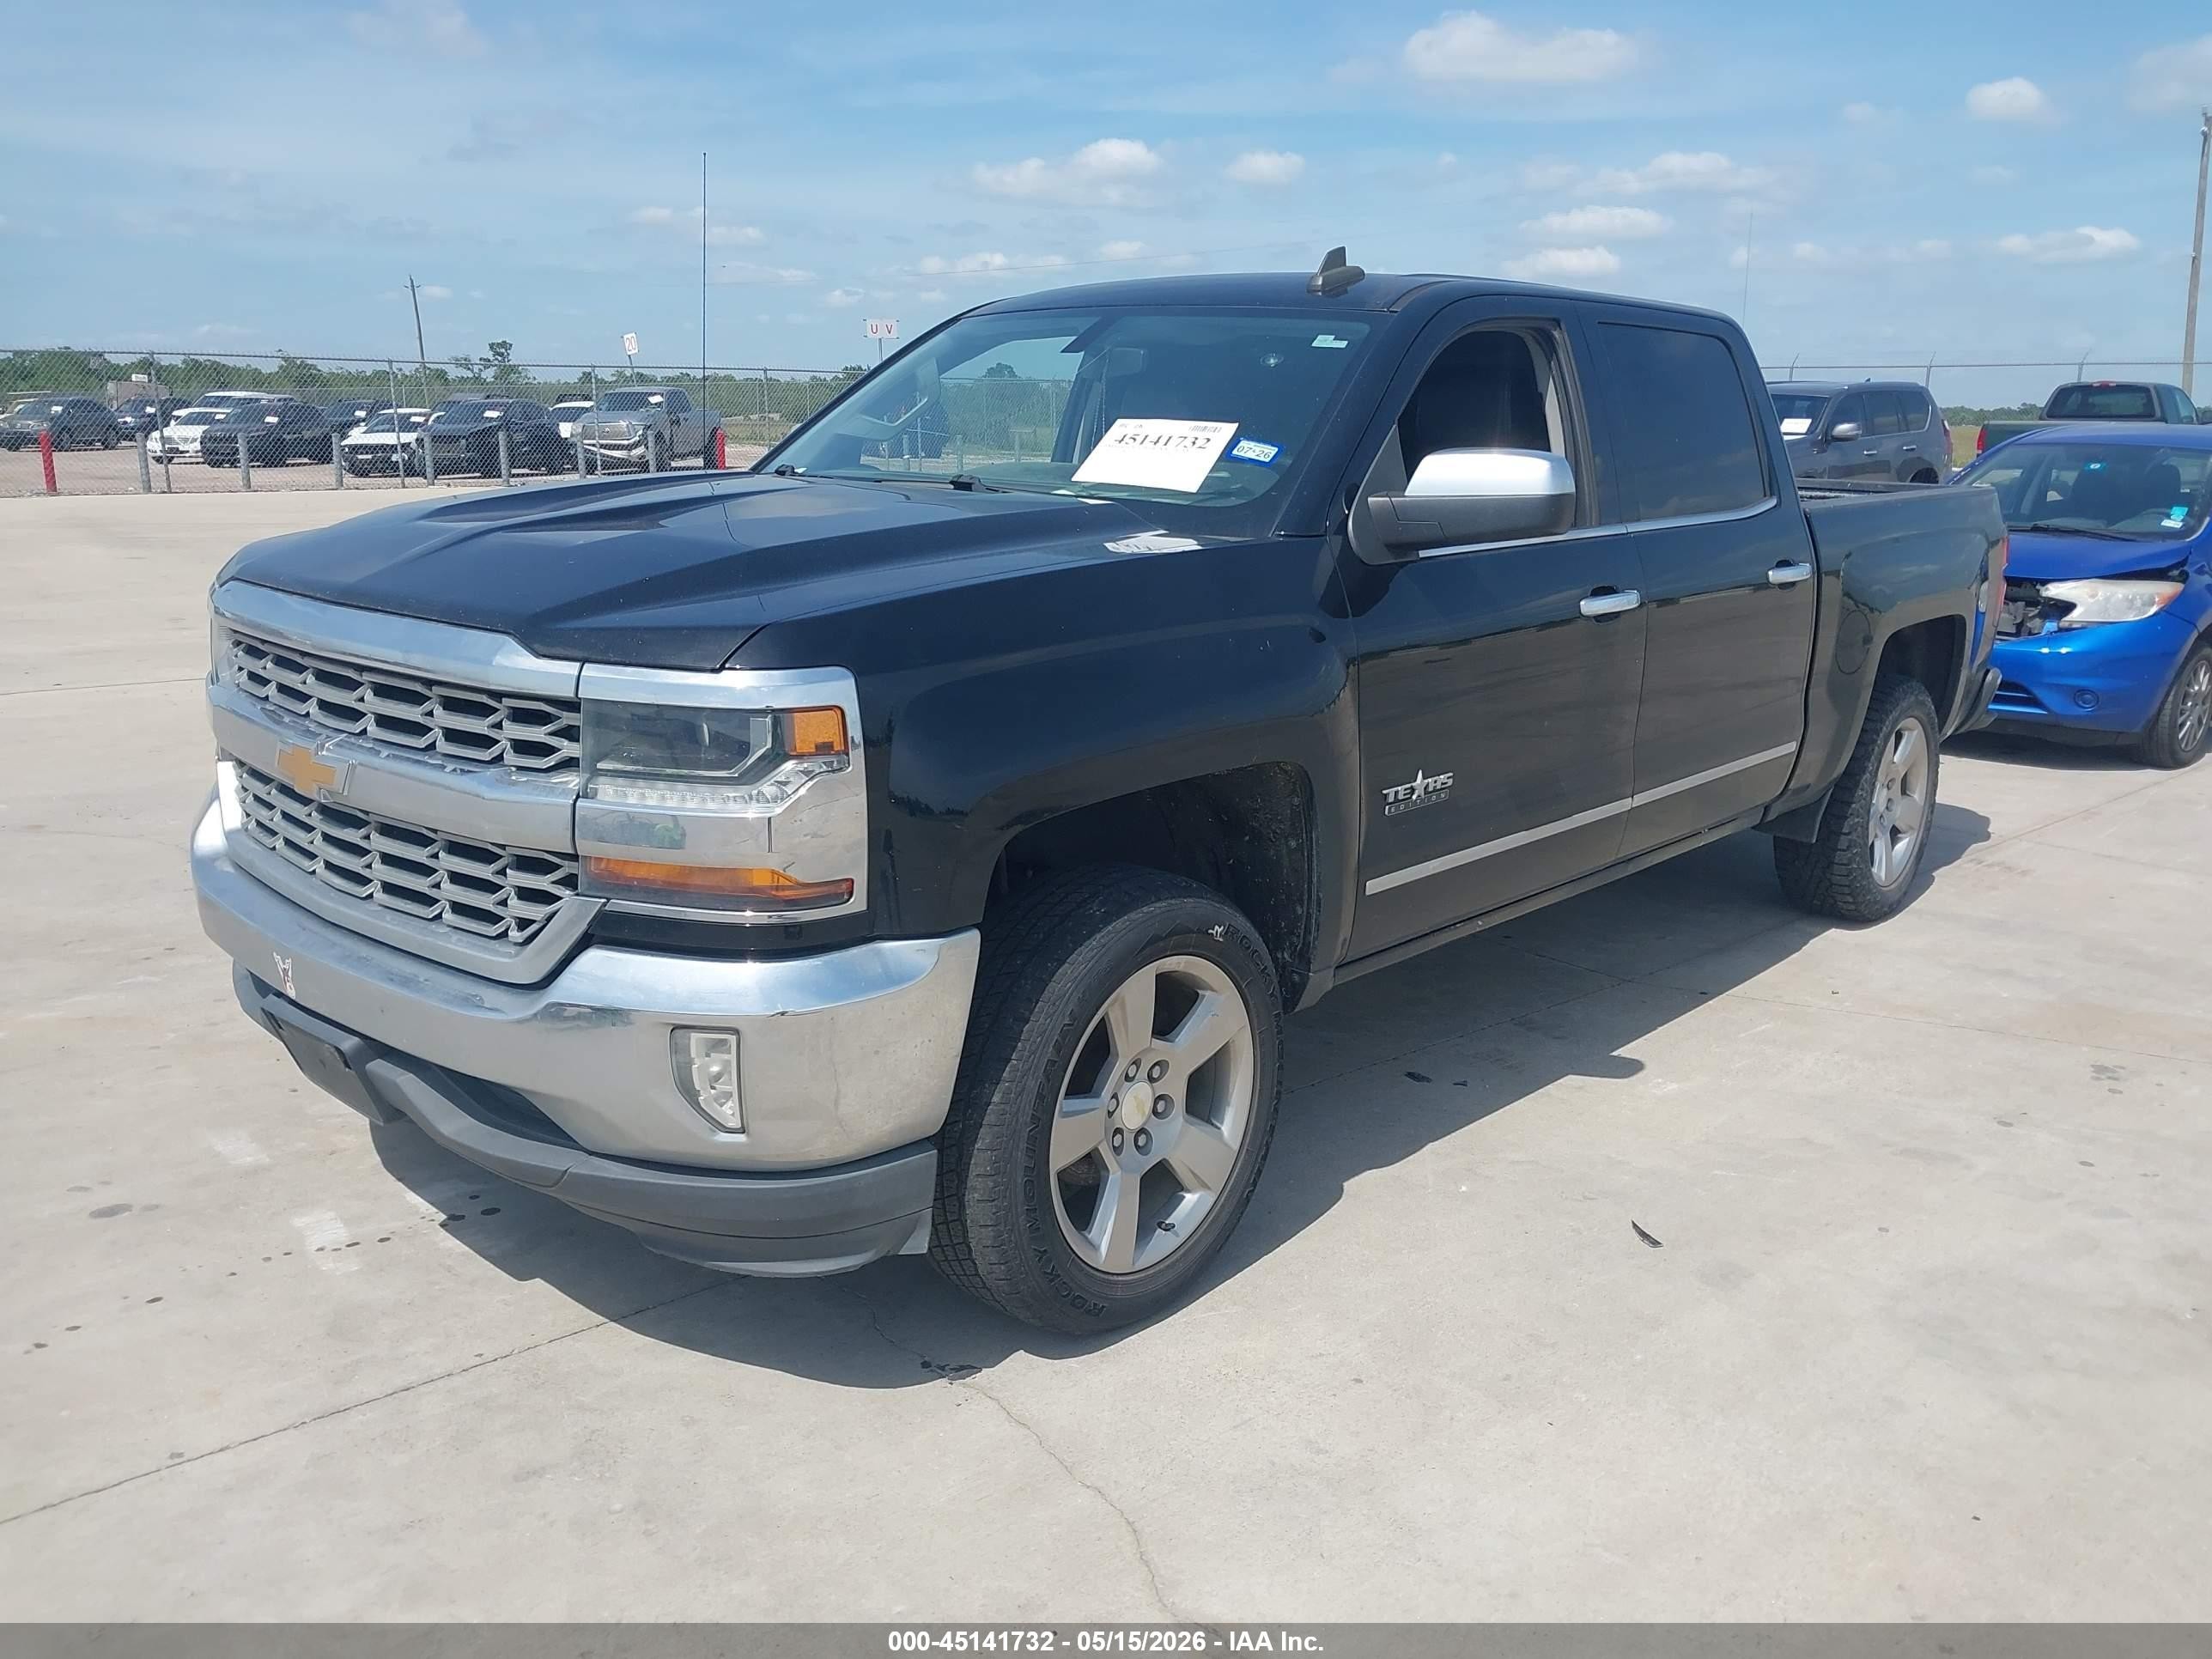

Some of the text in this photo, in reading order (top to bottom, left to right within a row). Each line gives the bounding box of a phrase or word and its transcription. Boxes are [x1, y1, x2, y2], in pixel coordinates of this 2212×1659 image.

[870, 323, 894, 335] U V
[624, 335, 637, 352] 20
[1113, 432, 1212, 451] 45141732
[1382, 769, 1454, 803] TEXAS
[1390, 793, 1446, 812] EDITION
[1031, 1245, 1108, 1317] ROCKY
